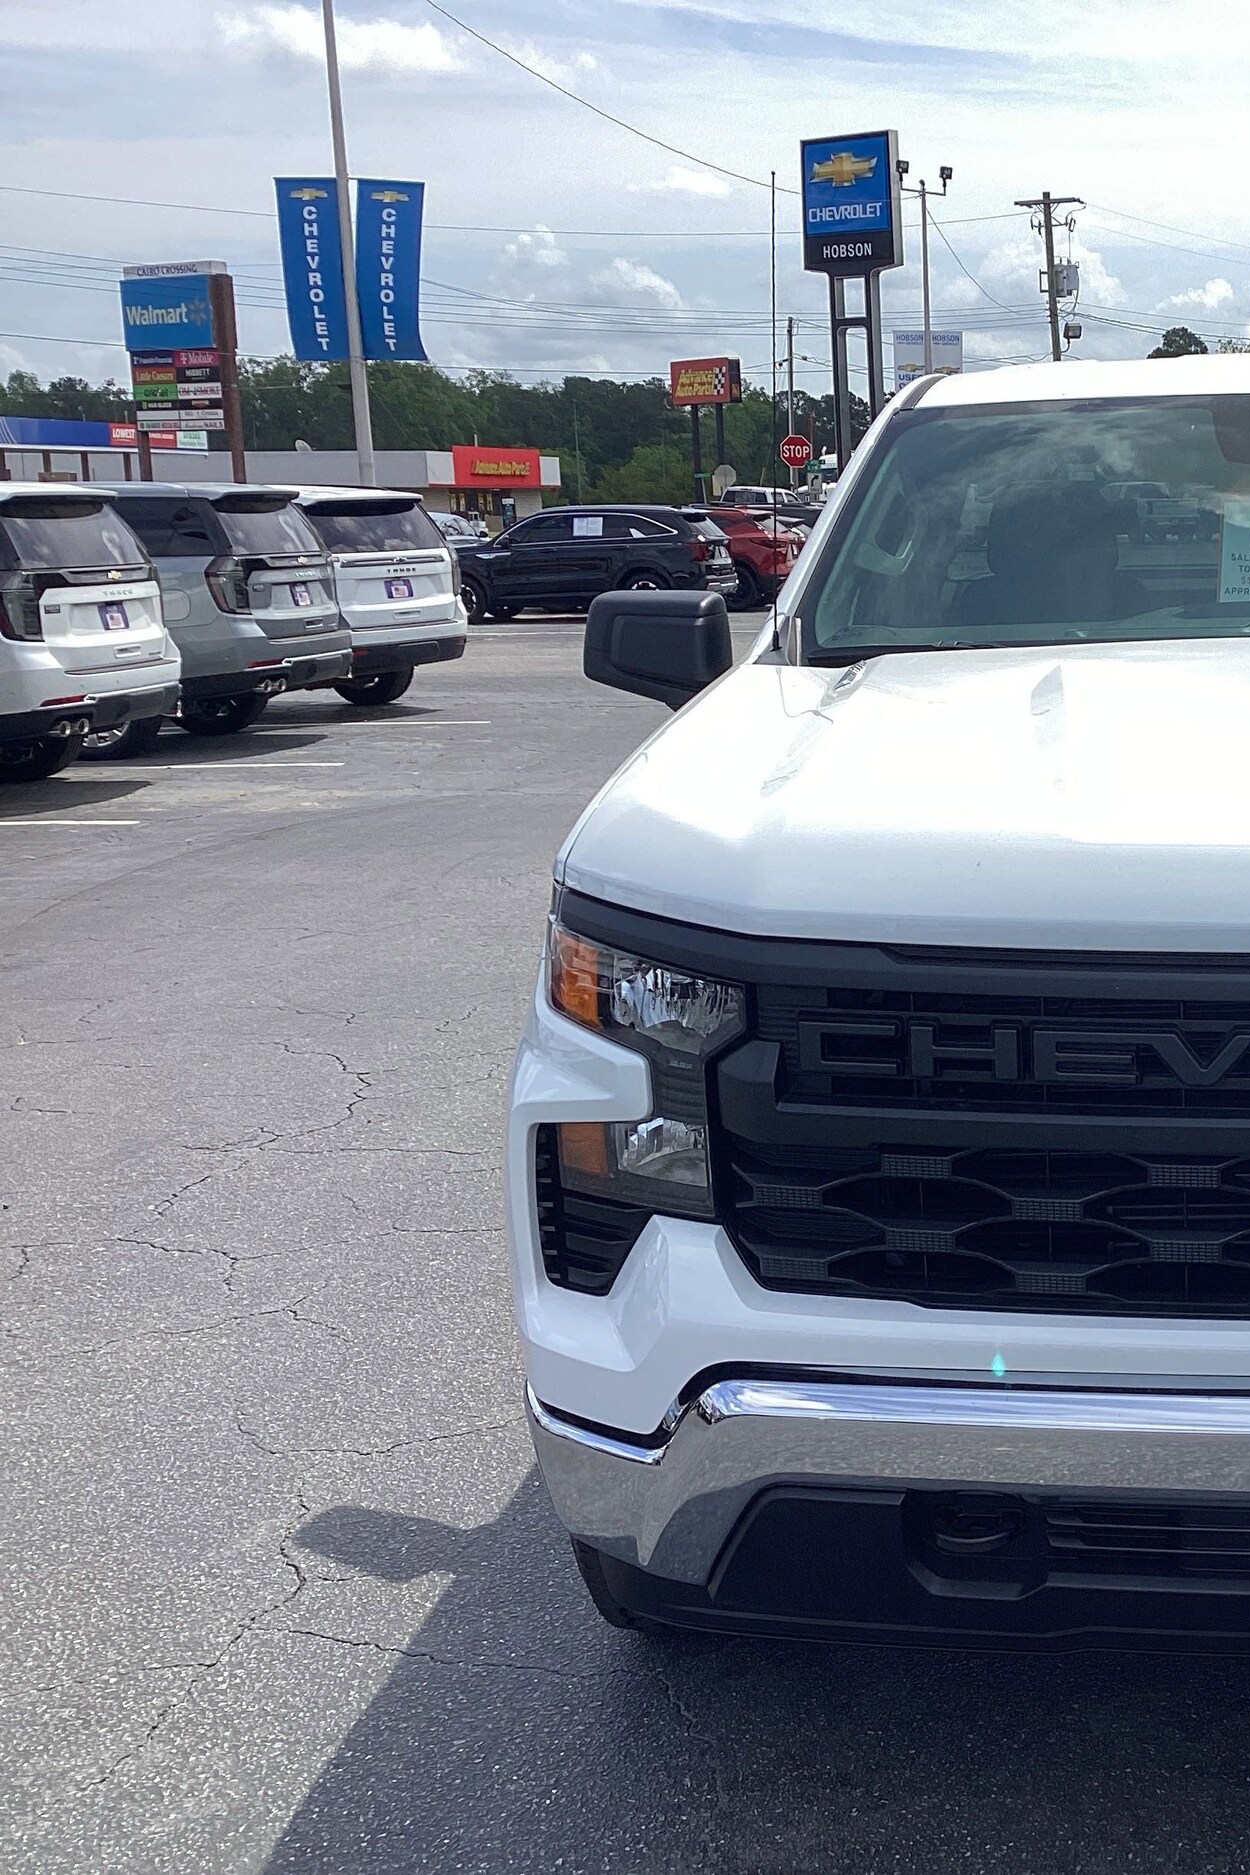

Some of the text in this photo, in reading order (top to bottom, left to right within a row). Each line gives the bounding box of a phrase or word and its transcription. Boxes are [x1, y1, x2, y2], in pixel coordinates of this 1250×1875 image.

[808, 202, 882, 222] CHEVROLET
[823, 242, 872, 258] HOBSON
[161, 264, 197, 275] CROSSING
[302, 205, 330, 351] CHEVROLET
[380, 208, 397, 351] CHEVROLET
[126, 303, 188, 325] Walmart
[896, 333, 924, 342] HOBSON
[932, 334, 960, 342] HOBSON
[783, 445, 810, 458] STOP
[1238, 564, 1250, 574] TO
